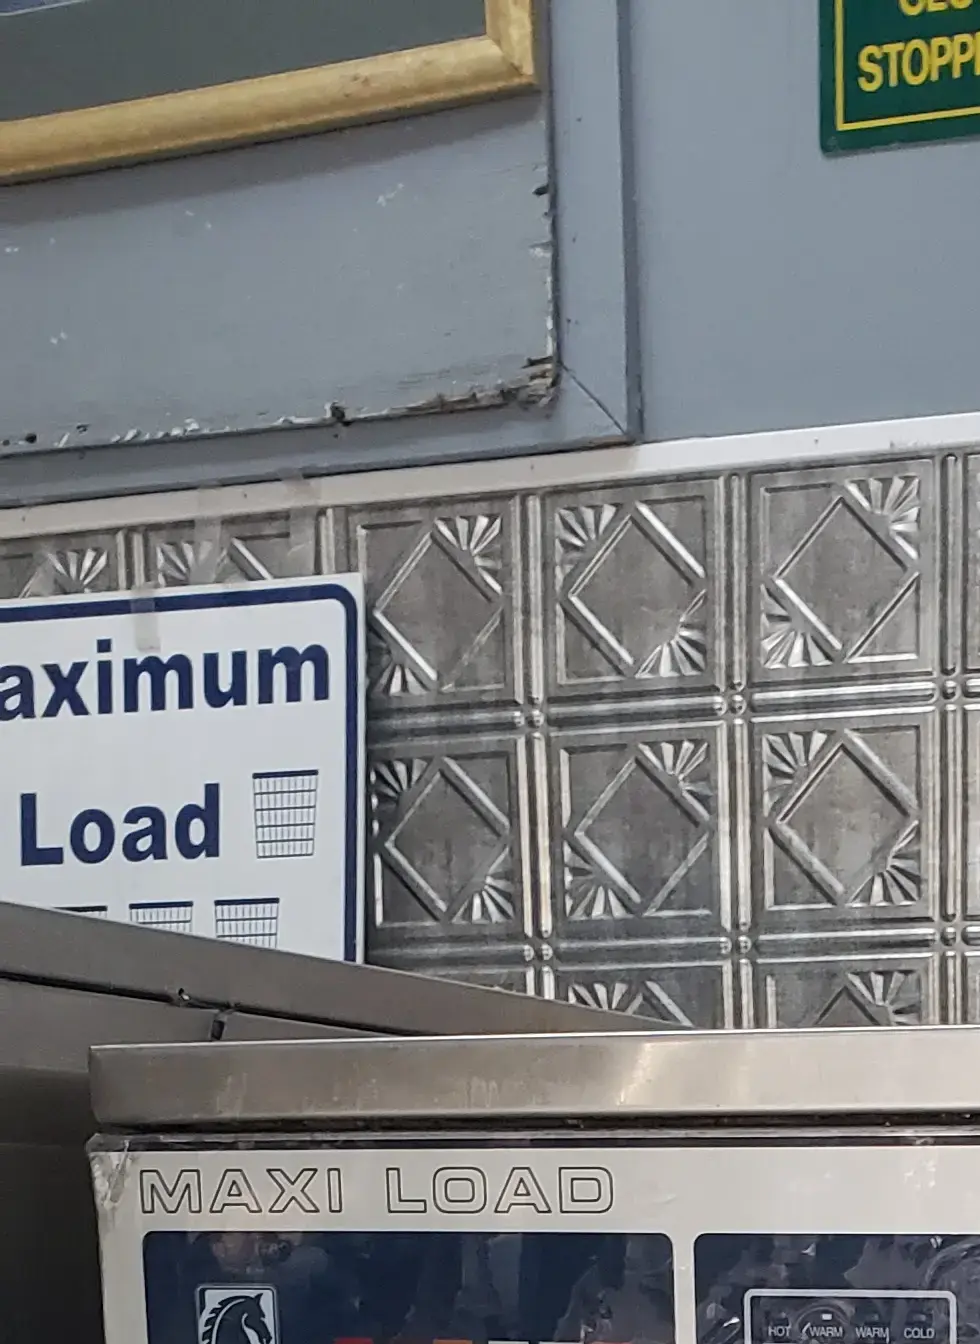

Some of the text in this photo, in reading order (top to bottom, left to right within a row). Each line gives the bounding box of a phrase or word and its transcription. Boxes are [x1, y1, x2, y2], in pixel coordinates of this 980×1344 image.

[20, 782, 220, 866] Load
[139, 1166, 614, 1214] MAXI LOAD
[768, 1326, 791, 1337] HOT
[810, 1326, 843, 1337] WARM
[855, 1327, 888, 1338] WARM
[903, 1328, 935, 1338] COLD
